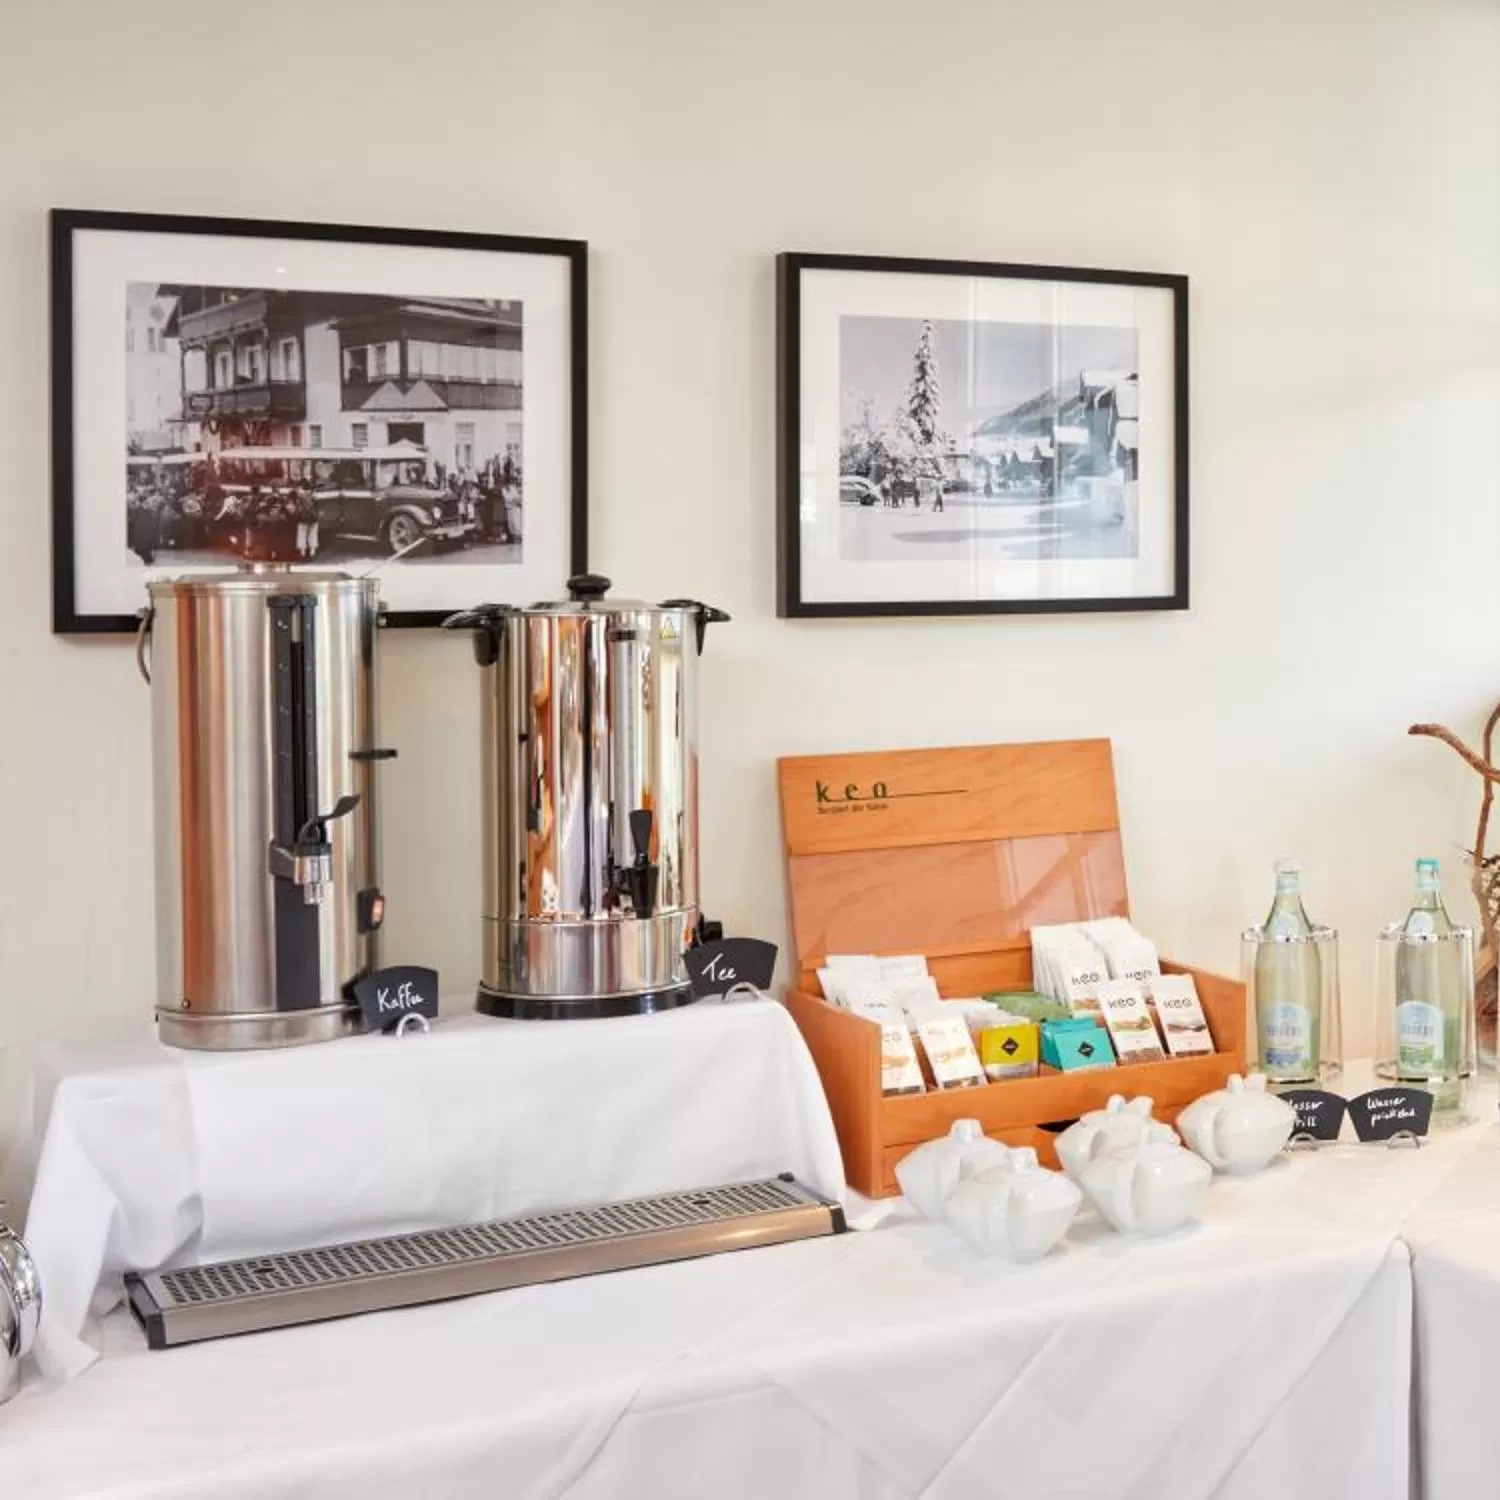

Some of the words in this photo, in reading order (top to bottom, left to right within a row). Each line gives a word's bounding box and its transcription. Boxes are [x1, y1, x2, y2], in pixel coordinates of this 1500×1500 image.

[815, 779, 887, 803] keo
[701, 952, 737, 983] Tee
[377, 981, 425, 1013] Kaffee
